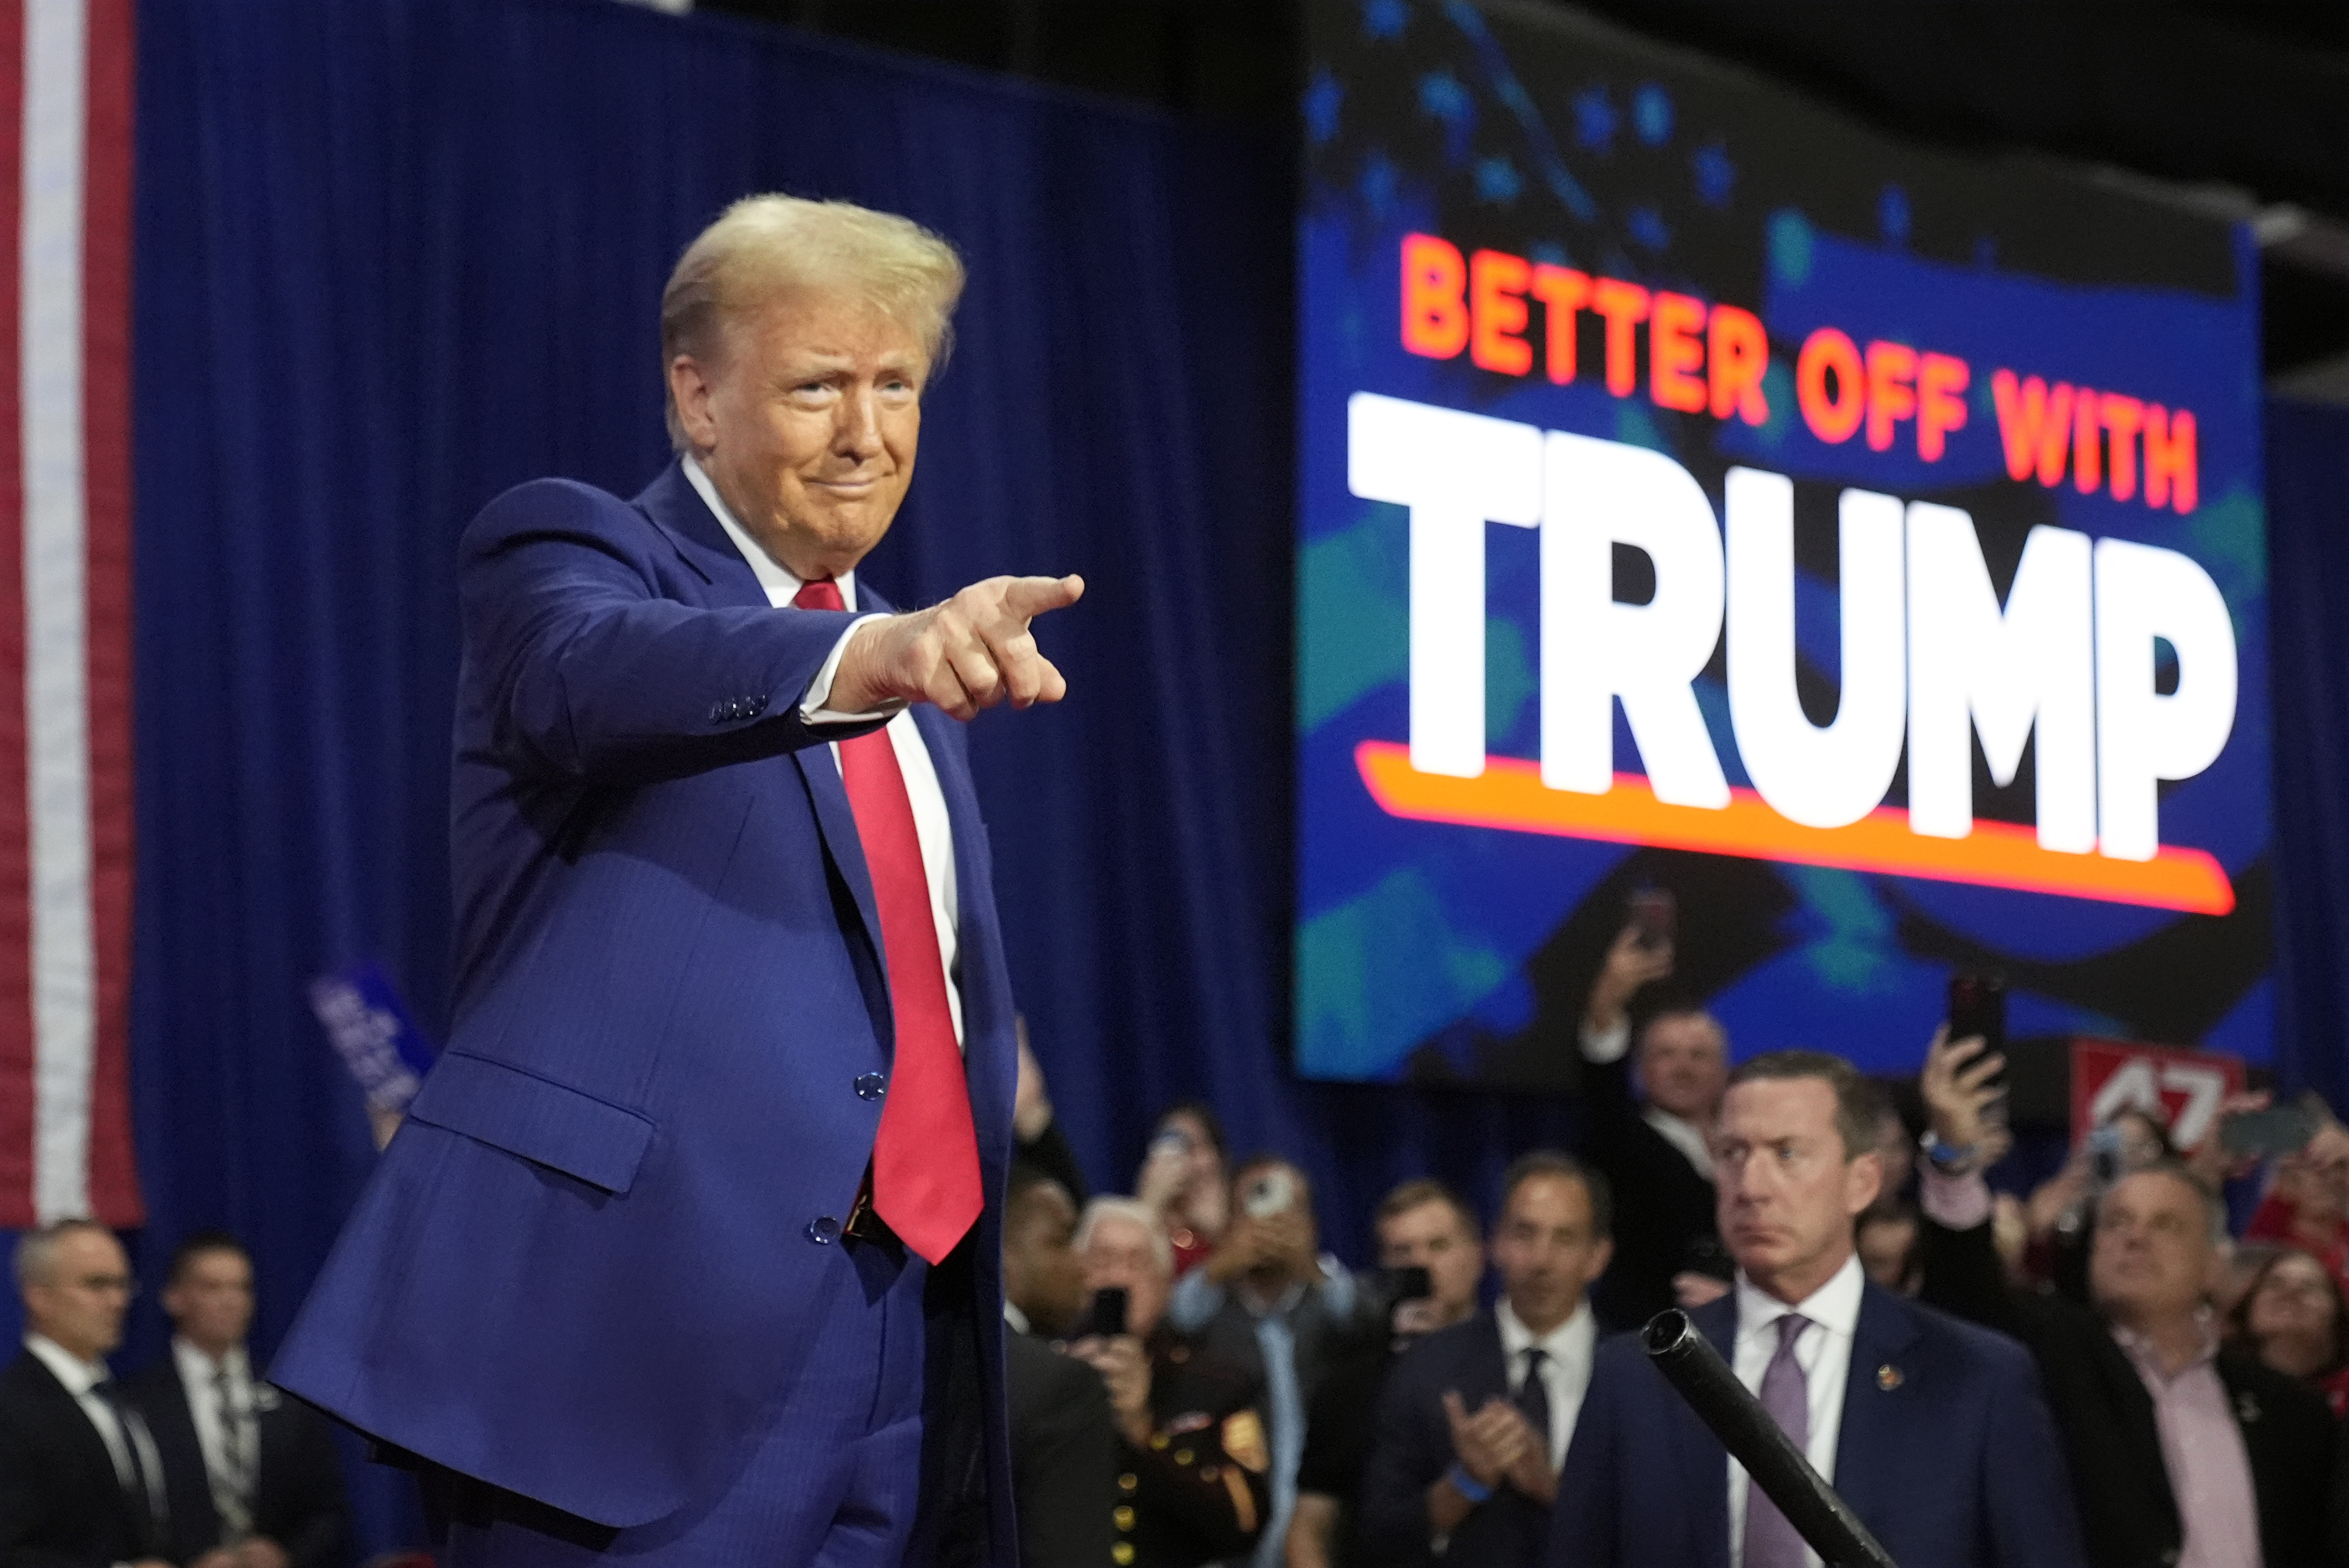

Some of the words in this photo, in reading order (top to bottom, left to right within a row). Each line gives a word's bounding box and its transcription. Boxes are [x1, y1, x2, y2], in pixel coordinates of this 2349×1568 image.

[1399, 232, 1771, 427] BETTER
[1795, 327, 1971, 463] OFF
[1991, 368, 2199, 516] WITH
[1347, 392, 2238, 863] TRUMP
